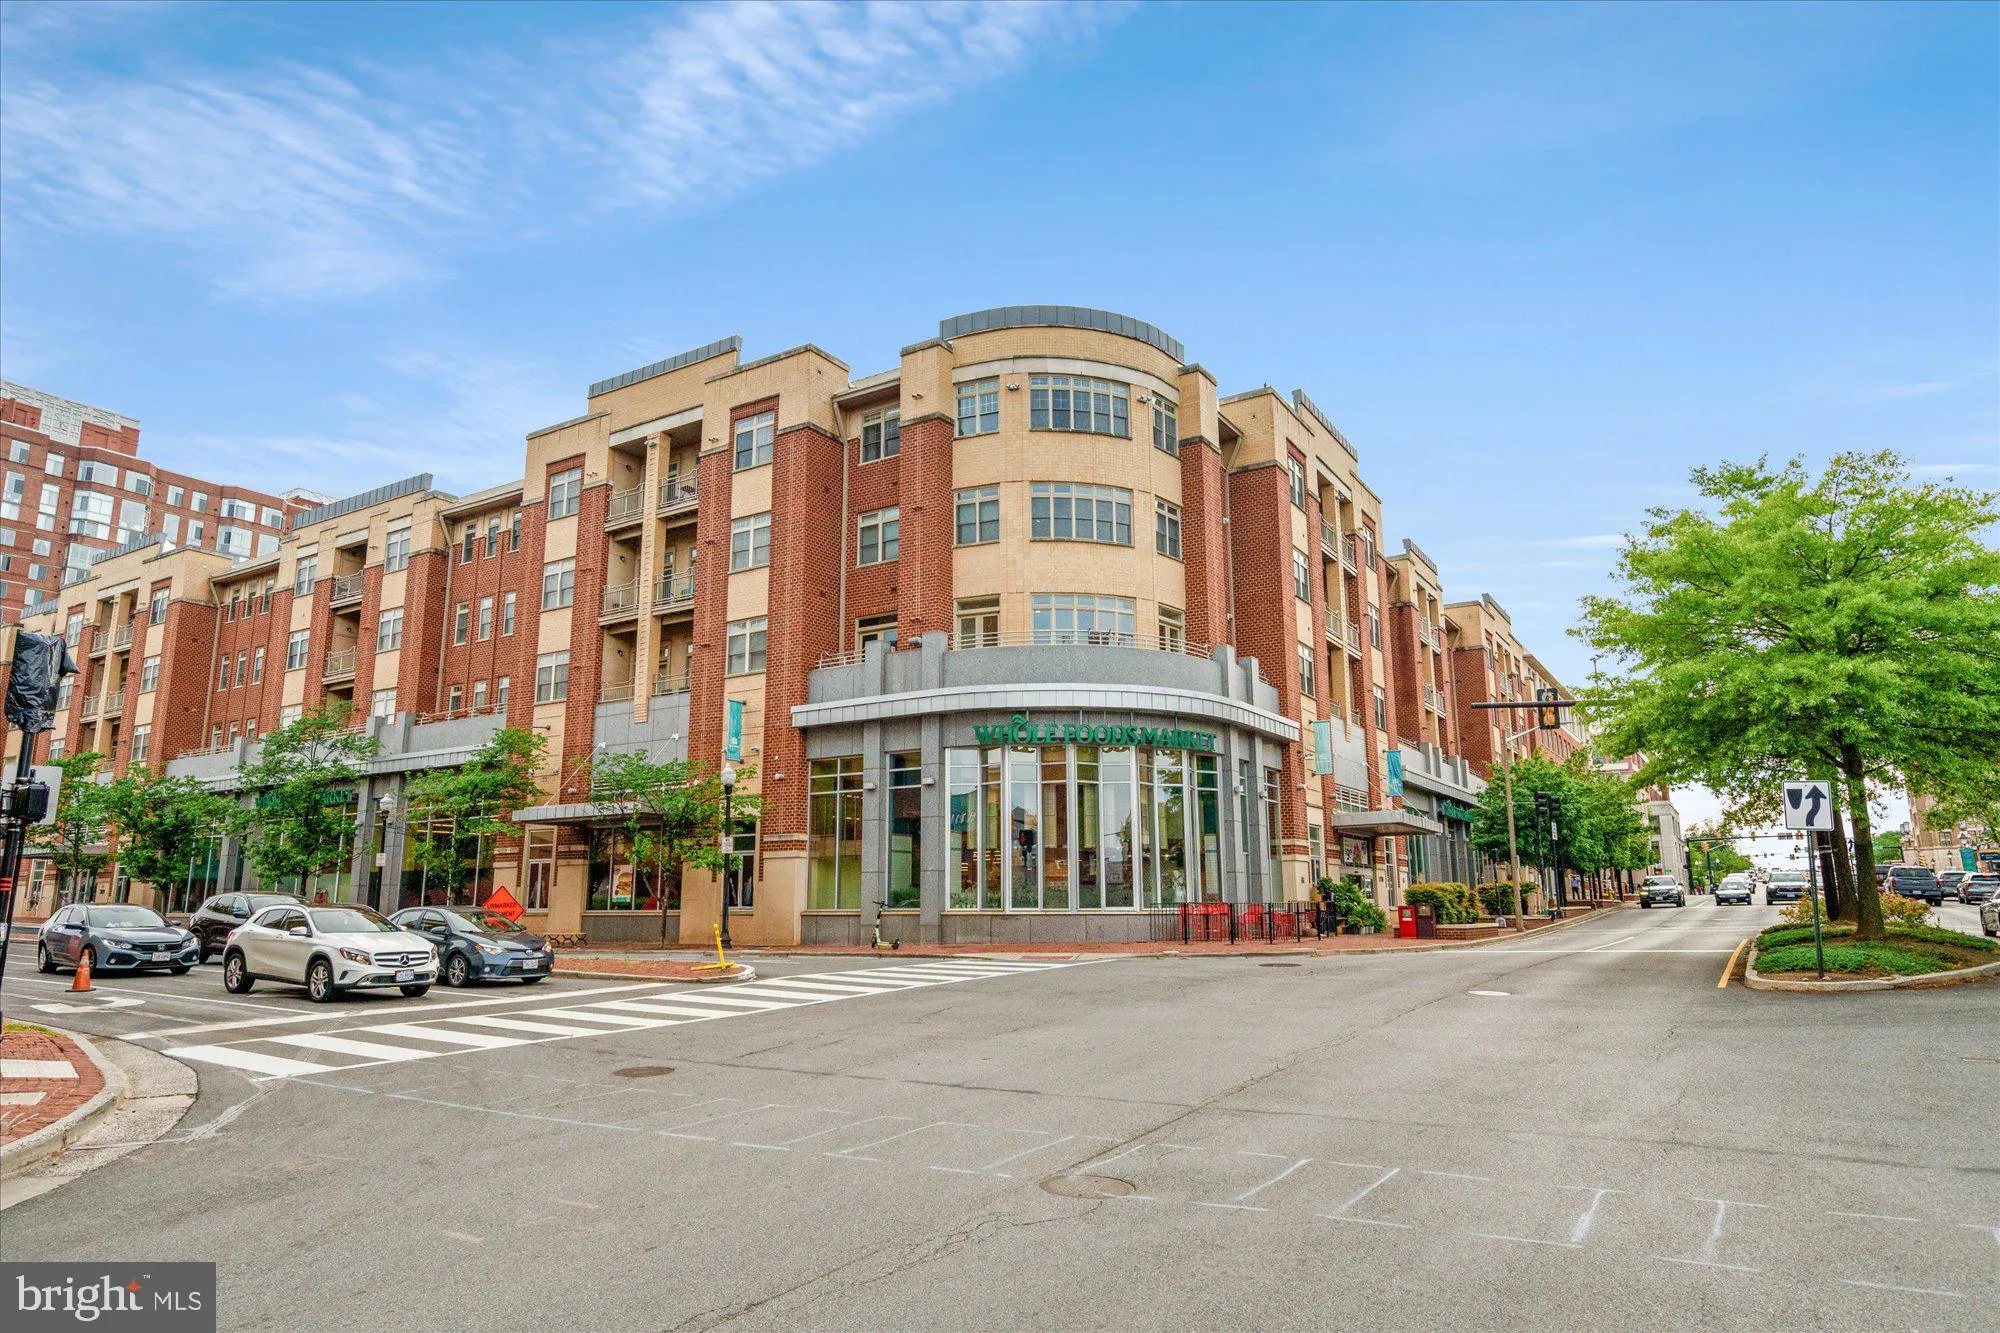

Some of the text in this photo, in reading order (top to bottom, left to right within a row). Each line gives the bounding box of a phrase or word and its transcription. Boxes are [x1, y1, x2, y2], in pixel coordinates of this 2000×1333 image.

[972, 718, 1217, 751] WHOLE FOODS MARKET
